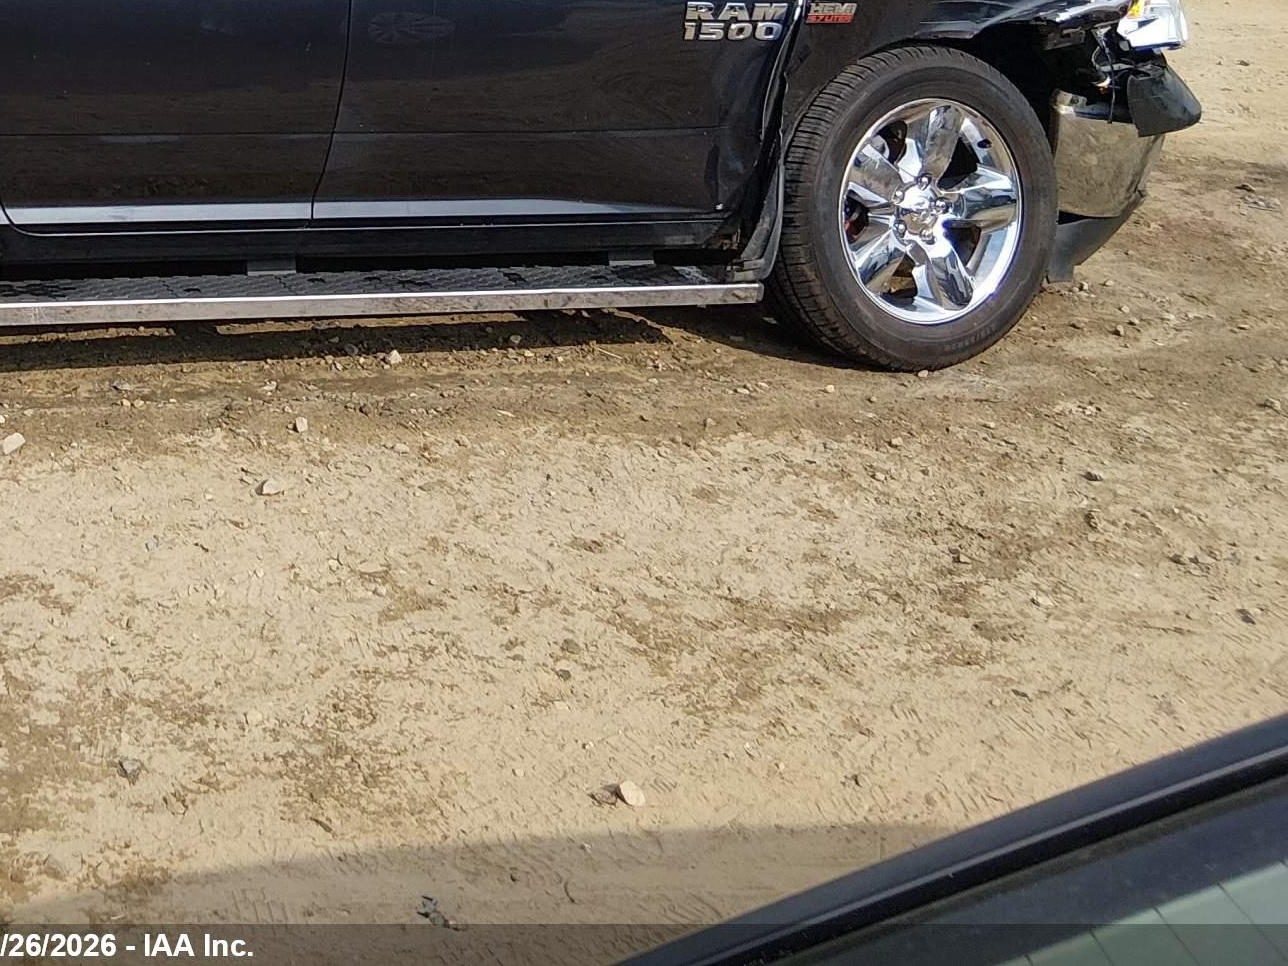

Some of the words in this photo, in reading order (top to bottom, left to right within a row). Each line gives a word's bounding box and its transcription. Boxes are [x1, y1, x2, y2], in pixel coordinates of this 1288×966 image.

[686, 2, 788, 20] RAM
[809, 3, 857, 15] HEMI
[684, 22, 784, 40] 1500
